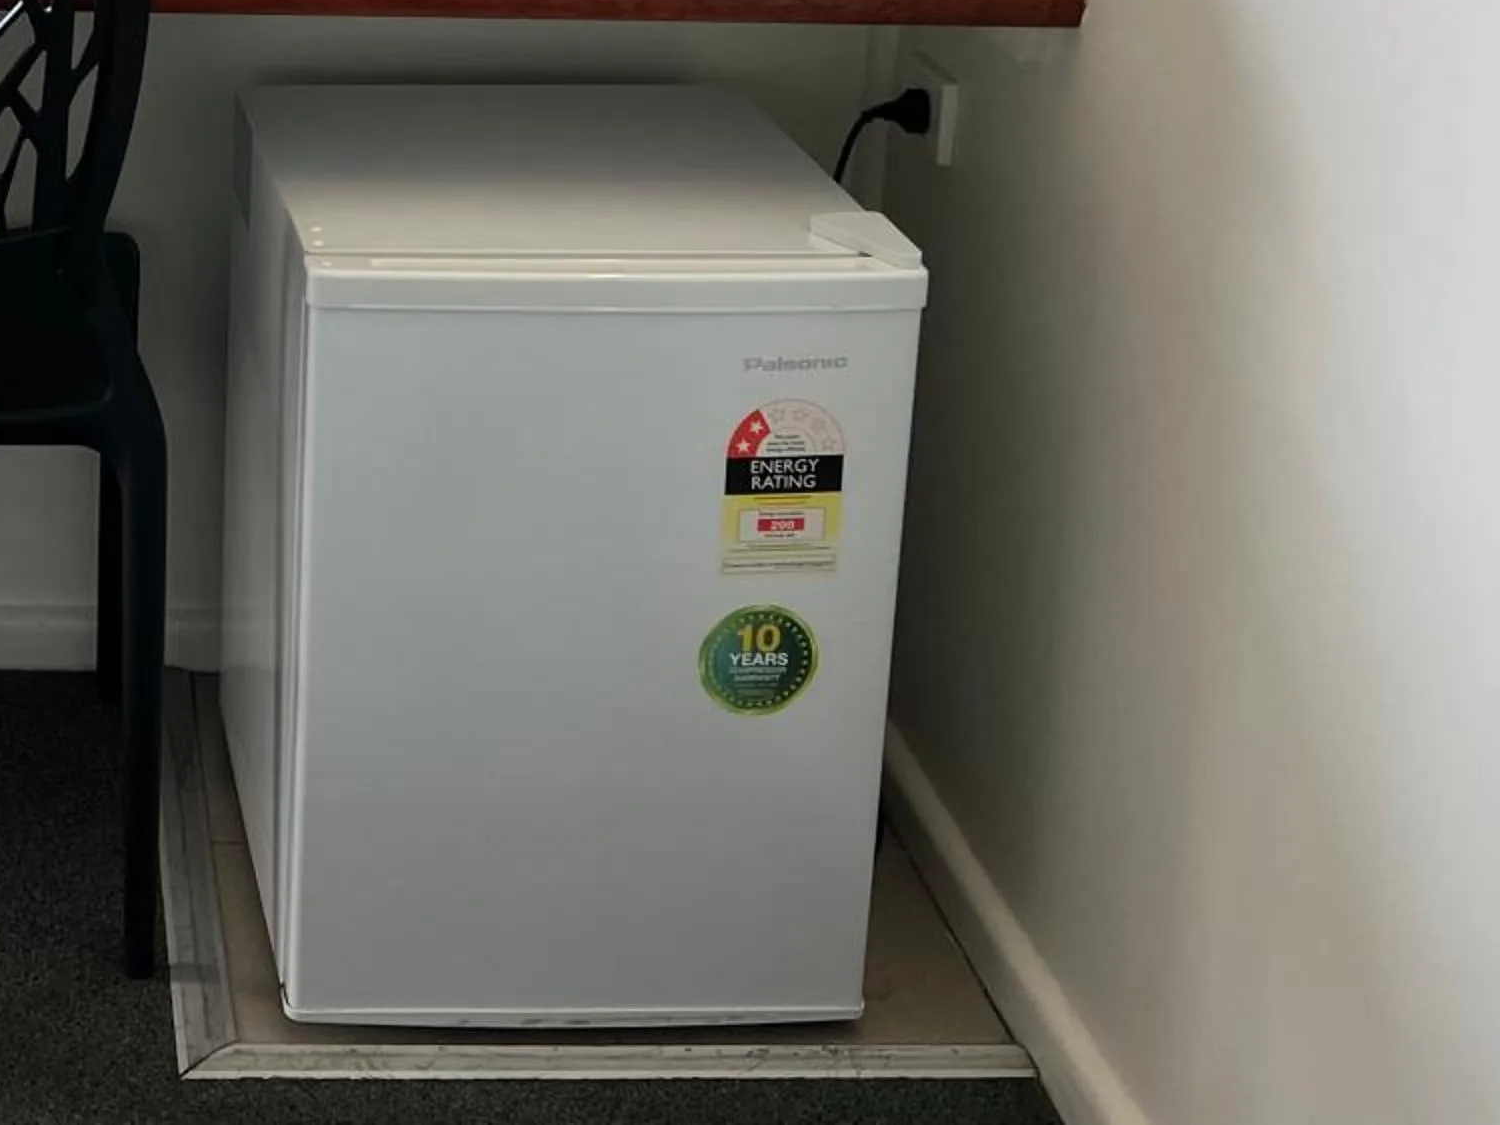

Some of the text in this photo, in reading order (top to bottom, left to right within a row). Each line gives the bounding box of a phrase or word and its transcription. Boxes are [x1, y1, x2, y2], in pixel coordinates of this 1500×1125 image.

[742, 355, 849, 373] Palsonic
[750, 458, 820, 474] ENERGY
[751, 474, 817, 490] RATING
[737, 623, 782, 652] 10
[729, 652, 789, 666] YEARS
